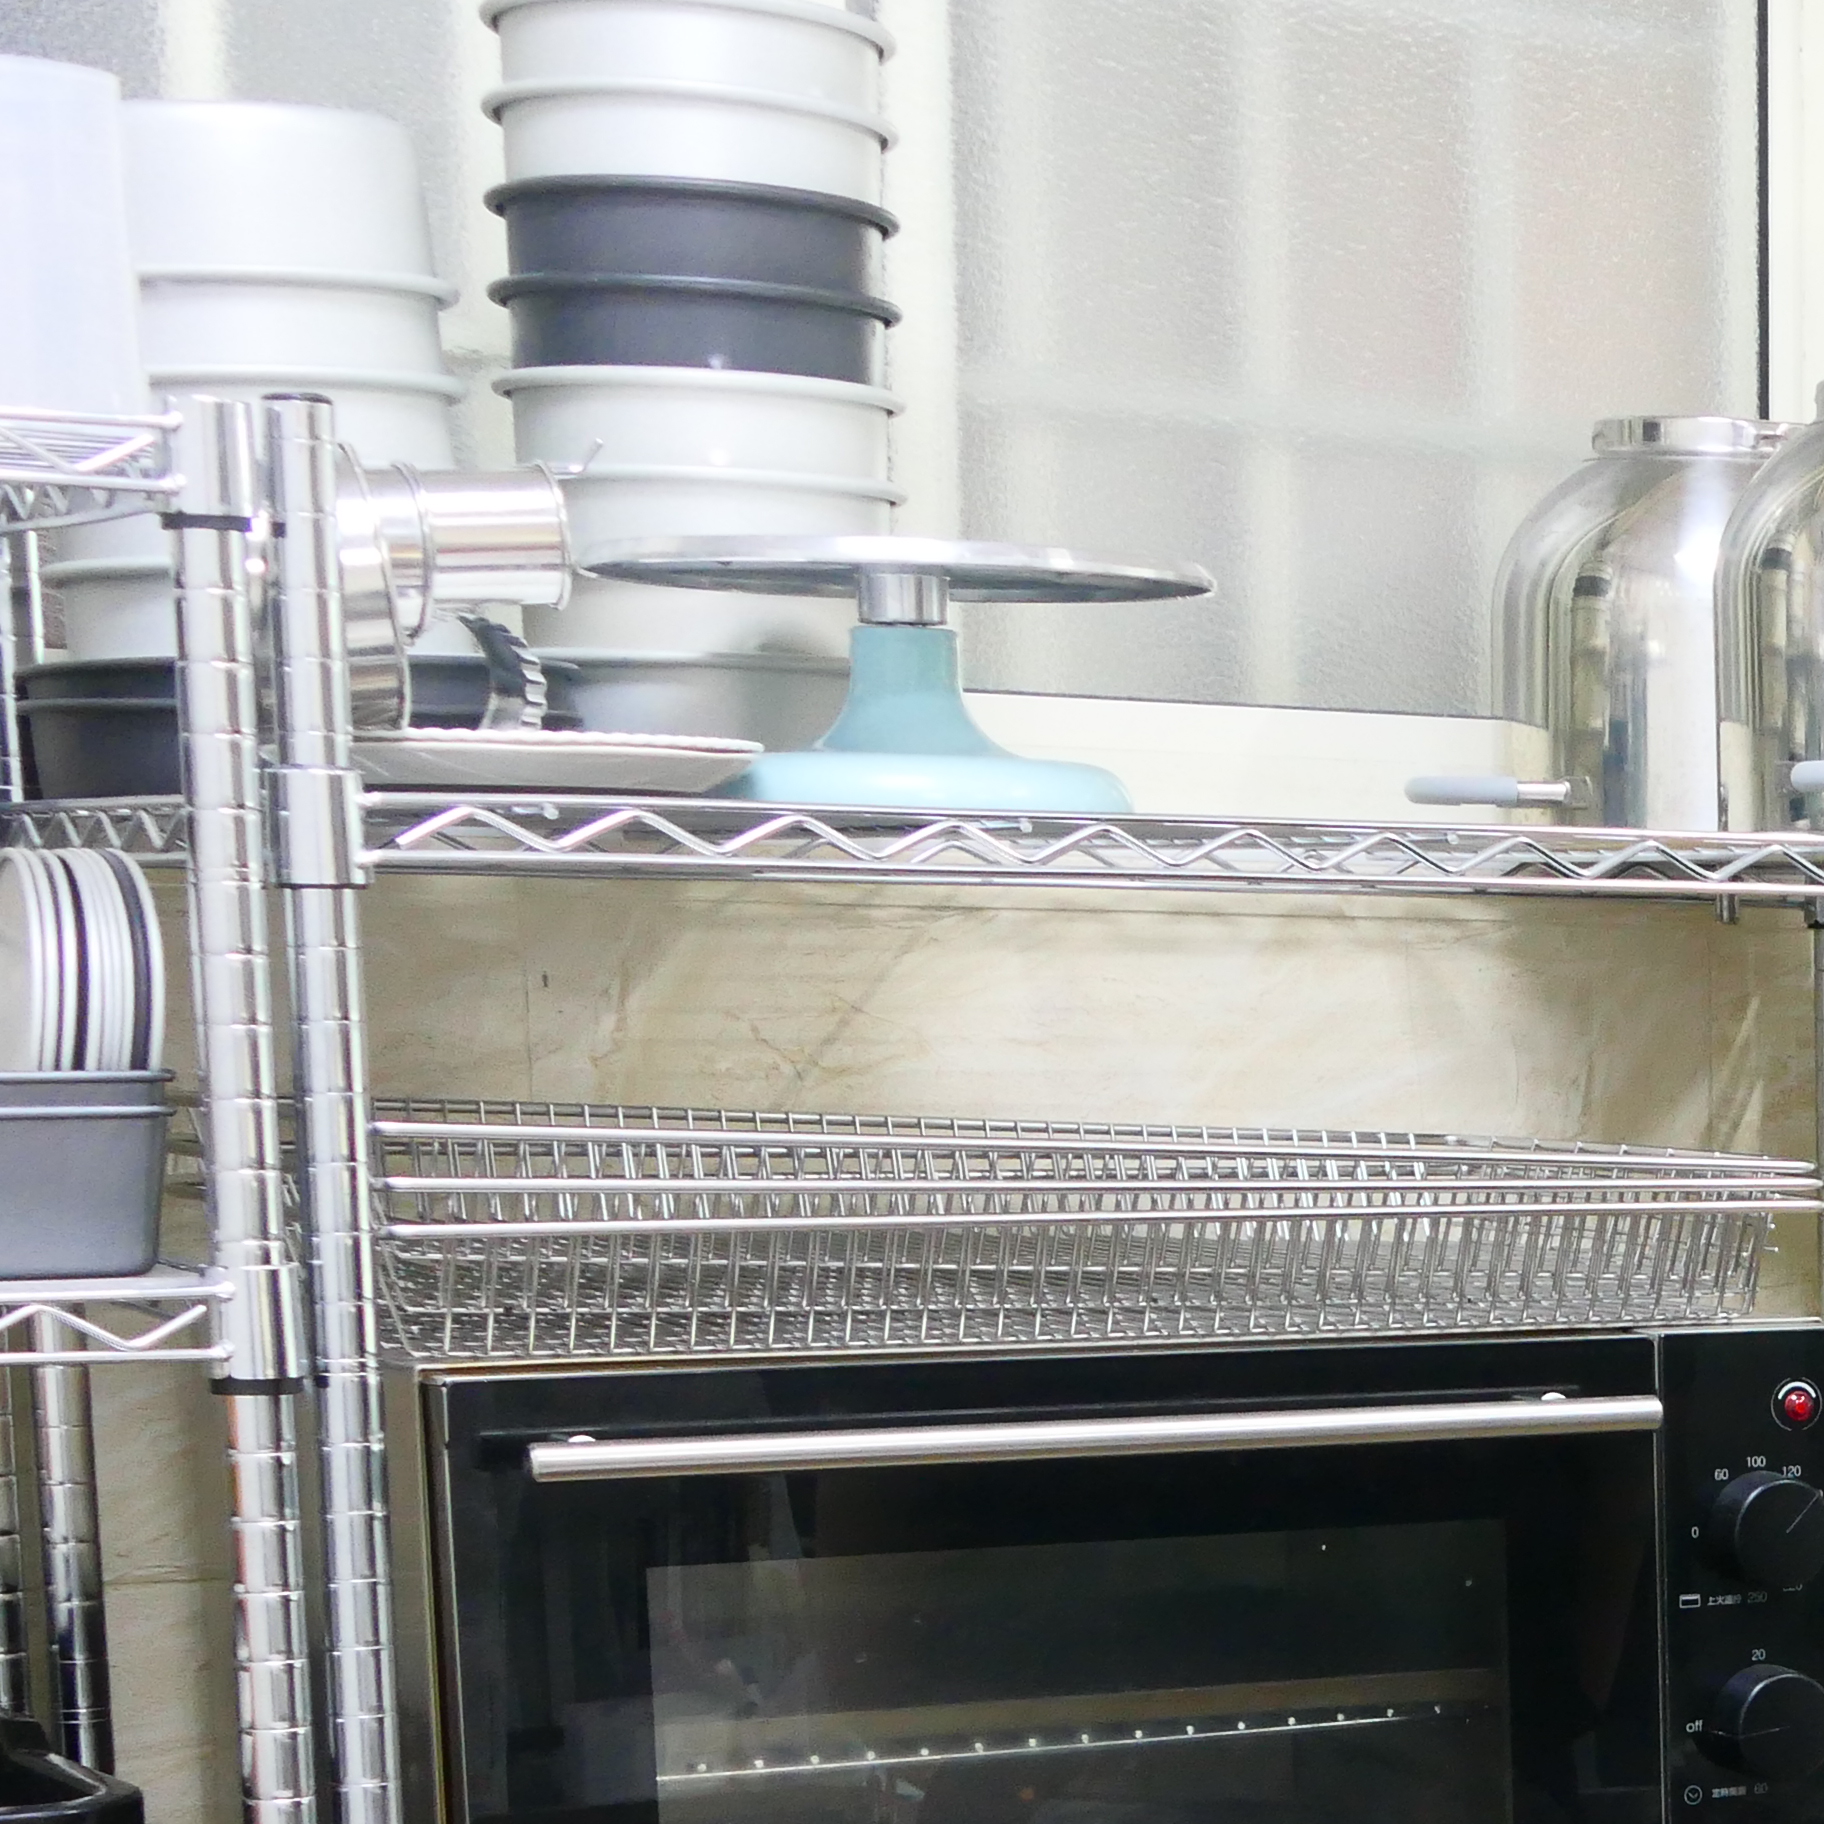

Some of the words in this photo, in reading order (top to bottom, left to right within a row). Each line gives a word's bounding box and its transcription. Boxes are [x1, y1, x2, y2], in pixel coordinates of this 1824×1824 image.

[1746, 1456, 1766, 1468] 100
[1714, 1469, 1729, 1481] 60
[1782, 1465, 1801, 1478] 120
[1691, 1526, 1699, 1539] 0
[1751, 1649, 1766, 1661] 20
[1686, 1720, 1703, 1733] off
